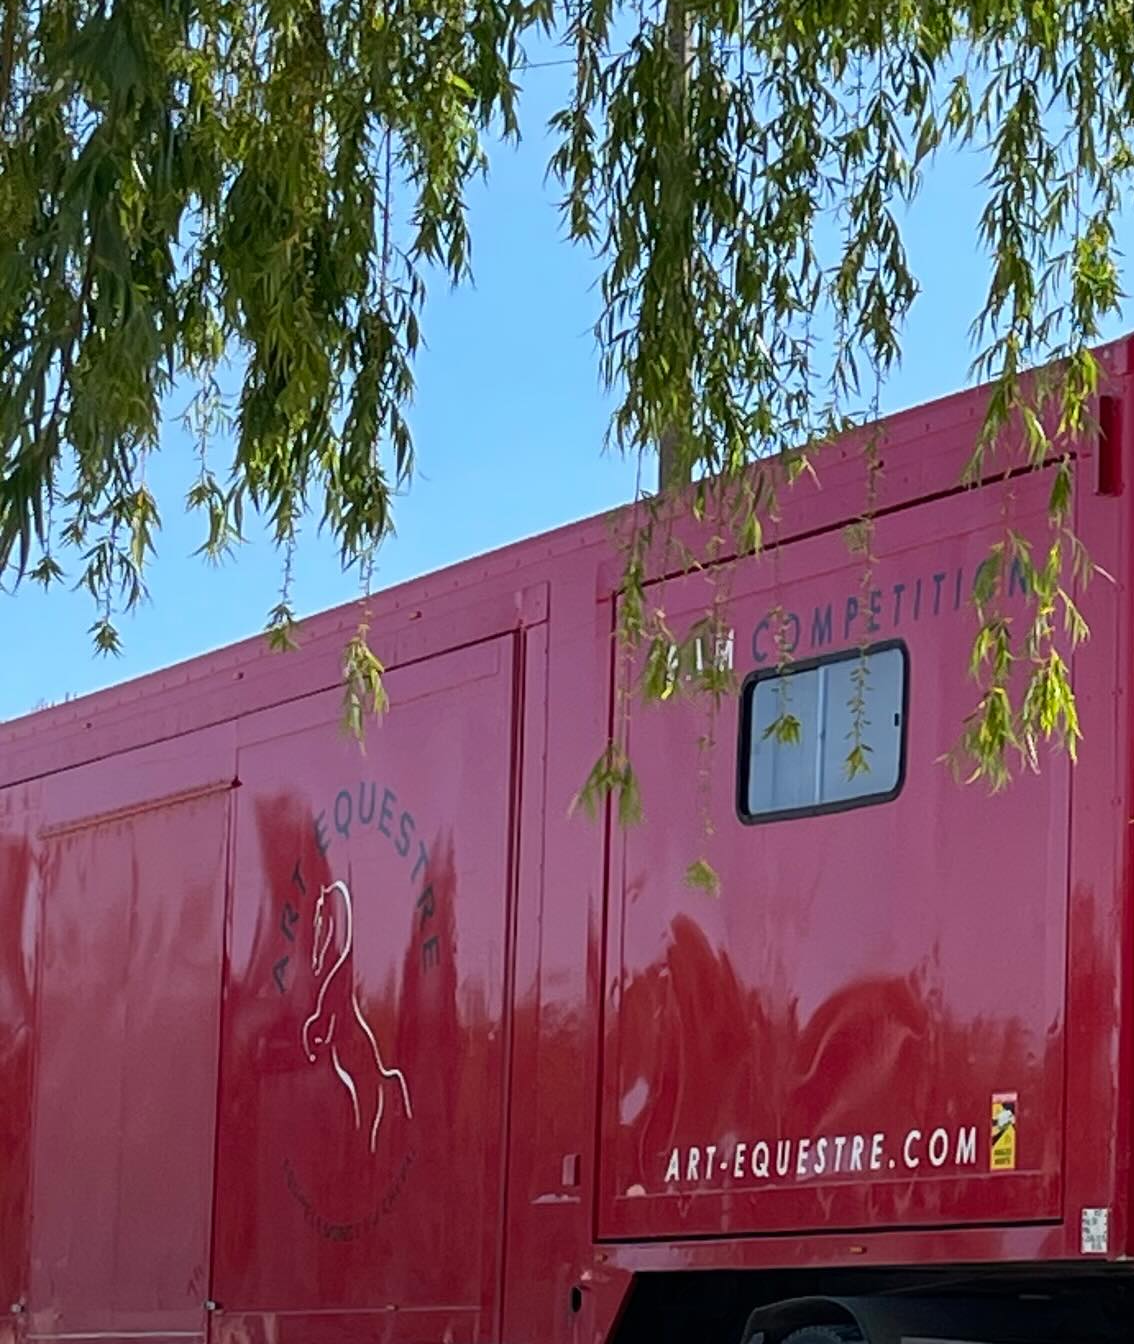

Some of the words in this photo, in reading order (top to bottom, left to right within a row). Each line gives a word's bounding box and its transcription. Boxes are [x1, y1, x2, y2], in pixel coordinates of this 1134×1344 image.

[272, 860, 307, 994] ART
[313, 780, 441, 974] EQUESTRE
[664, 1126, 976, 1182] ART-EQUESTRE.COM
